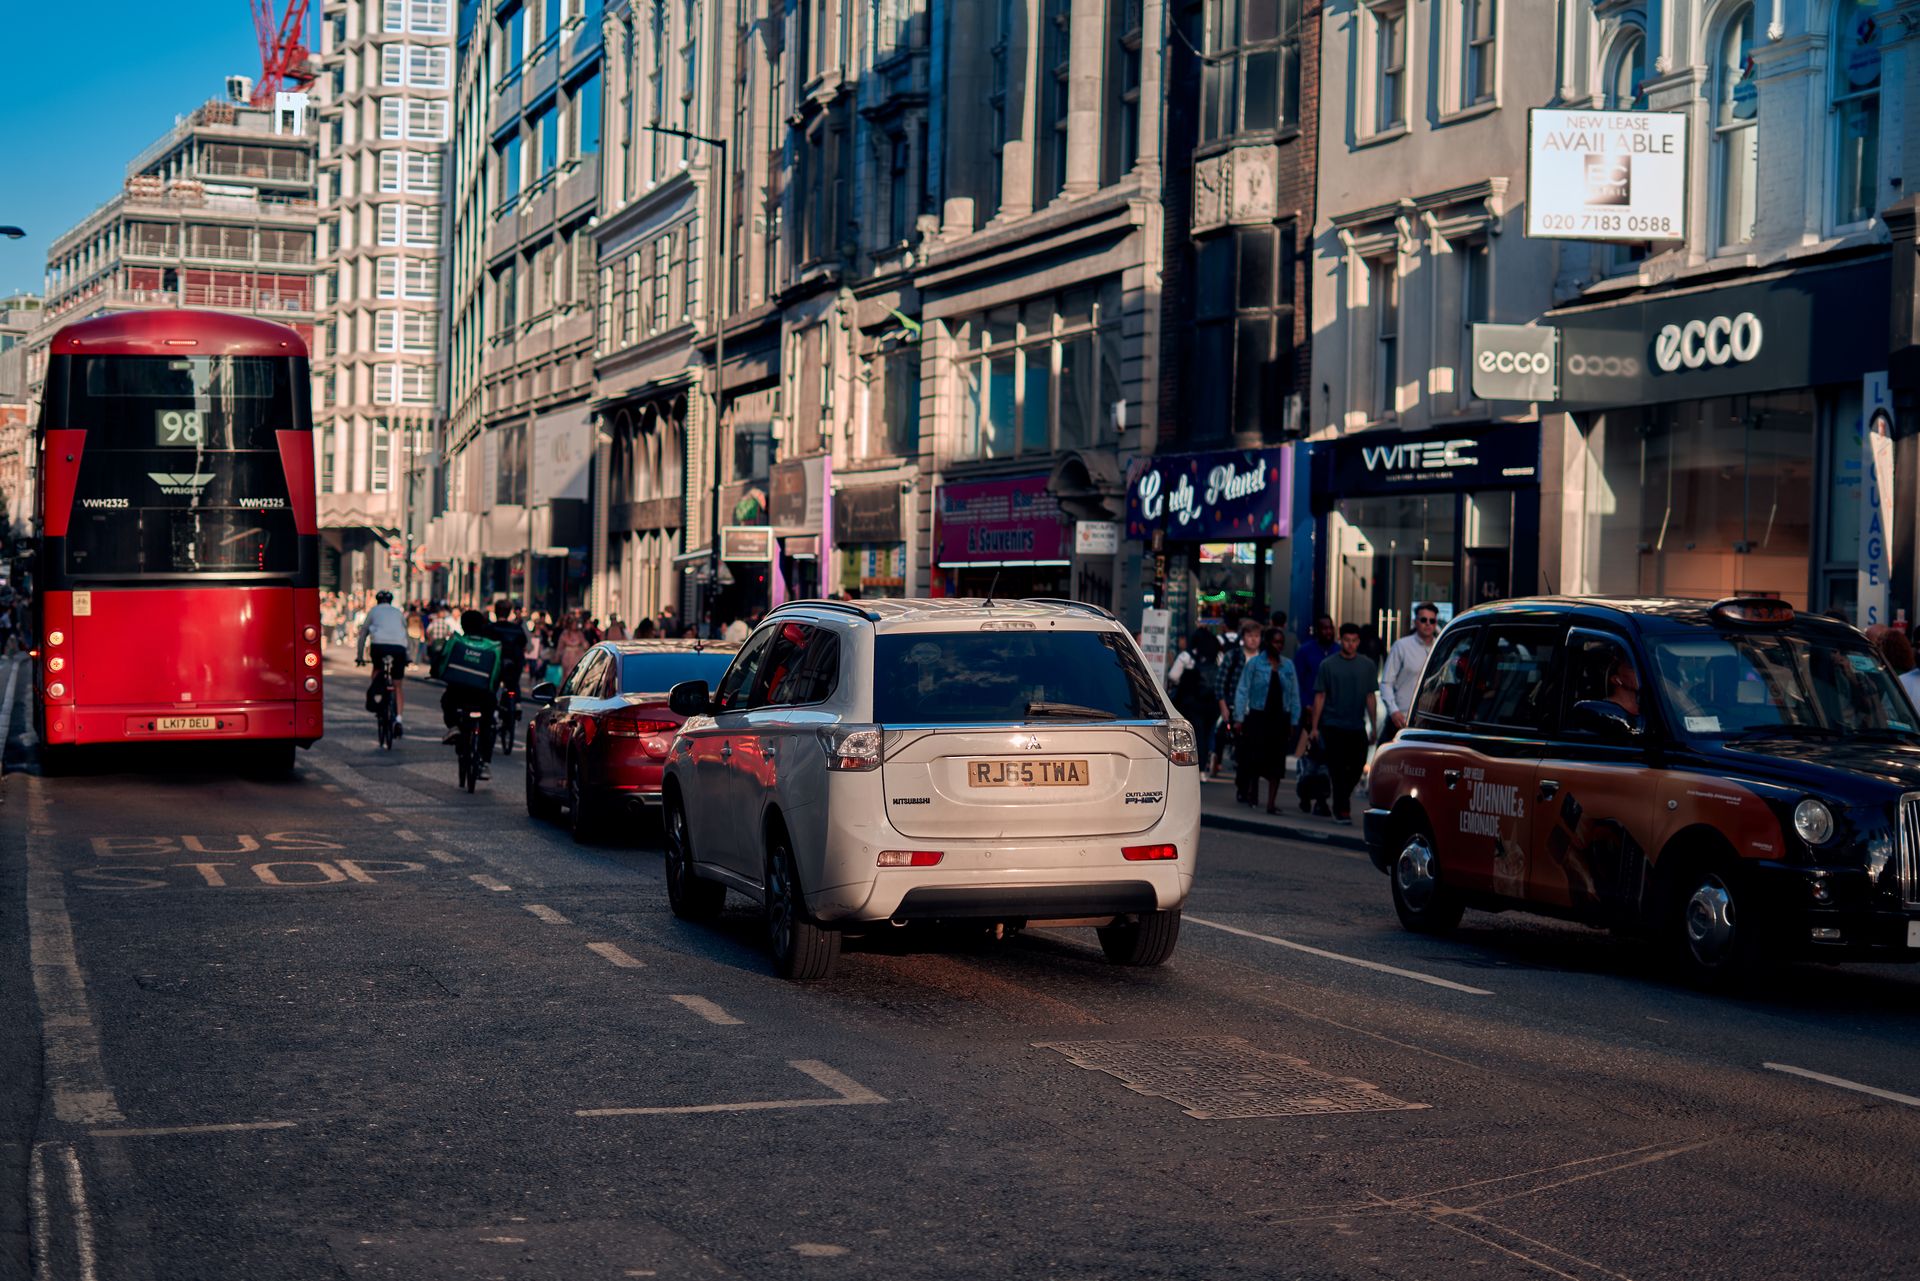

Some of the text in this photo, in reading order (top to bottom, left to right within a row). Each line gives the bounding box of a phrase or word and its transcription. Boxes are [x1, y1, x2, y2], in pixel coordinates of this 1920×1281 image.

[1566, 116, 1649, 131] NEW LEASE
[1543, 131, 1674, 154] AVAILABLE
[1543, 214, 1671, 232] 020 7183 0588
[1655, 311, 1764, 372] ecco
[1478, 350, 1551, 375] ecco
[161, 411, 204, 442] 98
[160, 486, 206, 495] WRIGHT
[1204, 457, 1266, 506] Planet
[82, 498, 129, 508] VWH2325
[239, 498, 285, 508] VWH2325
[979, 525, 1034, 553] Souvenirs
[163, 717, 210, 729] LK17 DEU
[977, 761, 1080, 784] RJ65 TWA
[892, 797, 931, 805] MITSUBISHI
[1125, 790, 1164, 798] OUTLANDER
[1125, 796, 1164, 805] PHEV
[1469, 781, 1525, 817] JOHNNIE &
[1459, 810, 1501, 838] LEMONADE
[90, 831, 346, 857] BUS
[72, 858, 427, 891] STOP
